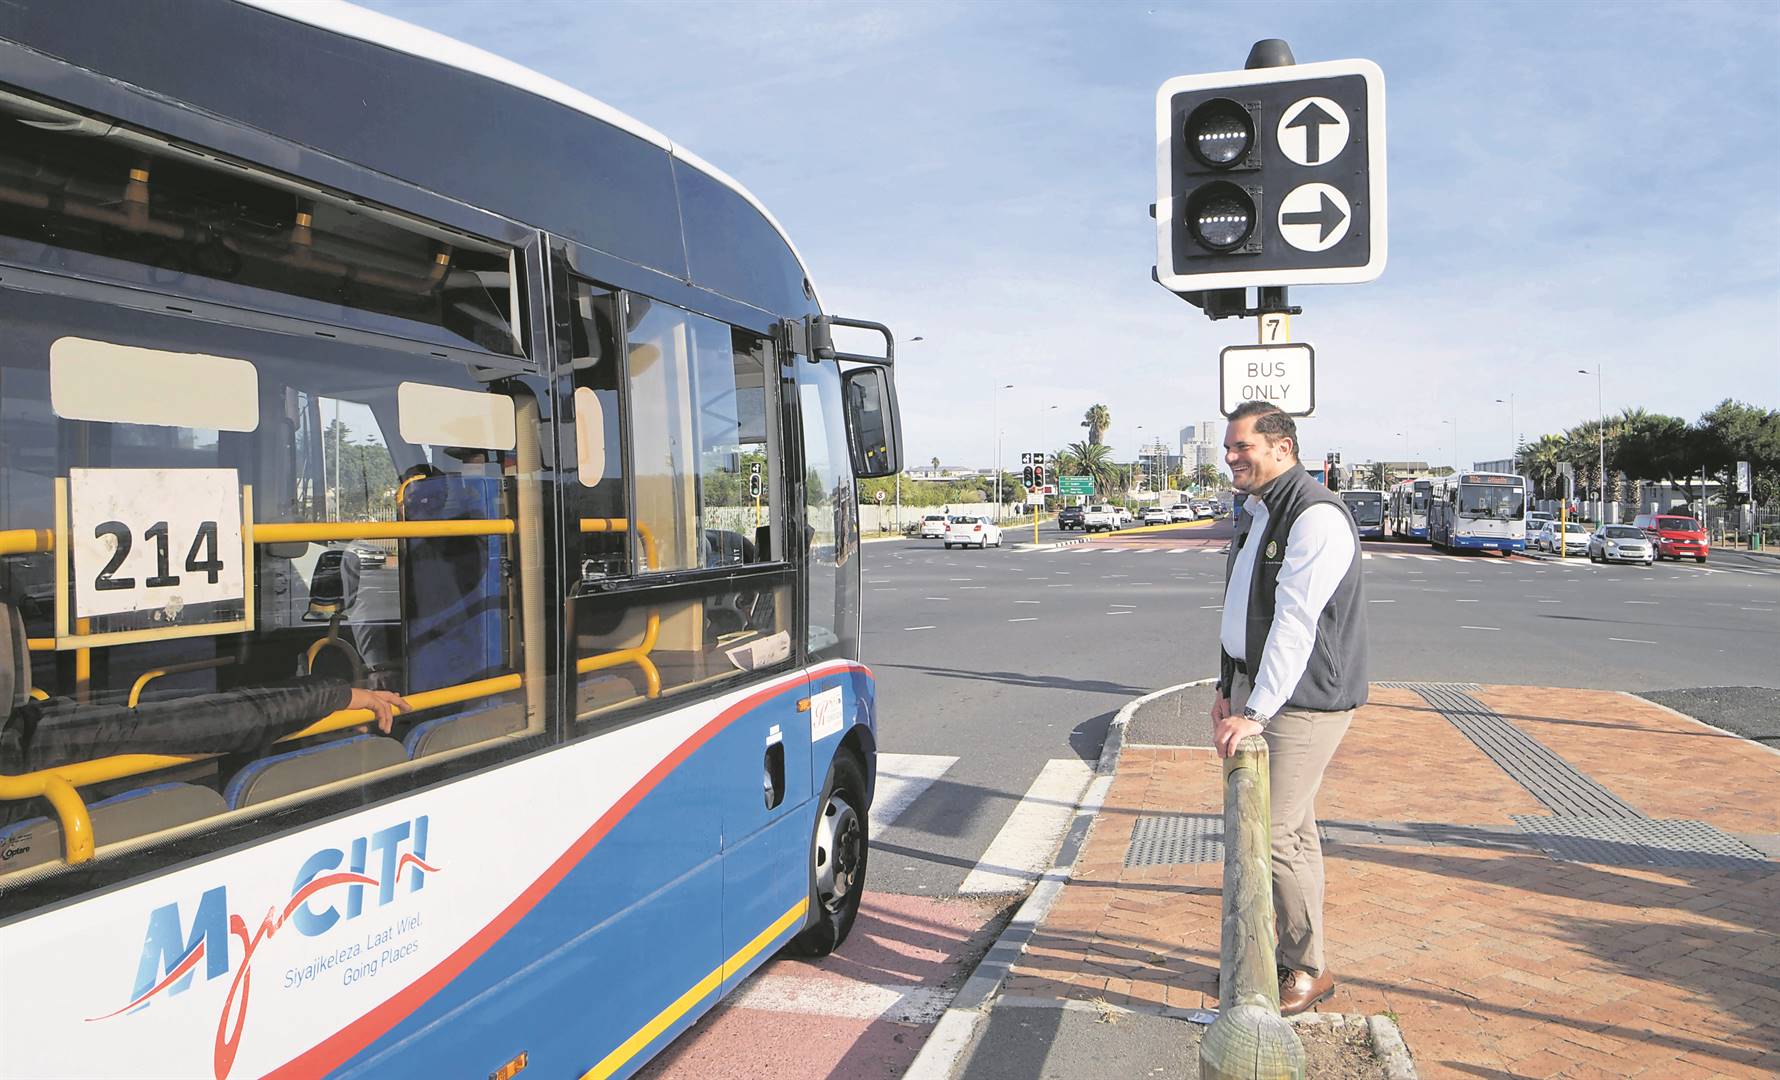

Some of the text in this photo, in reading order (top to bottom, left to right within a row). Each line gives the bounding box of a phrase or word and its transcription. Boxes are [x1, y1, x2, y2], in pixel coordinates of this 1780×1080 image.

[1266, 319, 1280, 341] 7
[1247, 361, 1286, 378] BUS
[1242, 384, 1290, 400] ONLY
[94, 520, 224, 591] 214
[367, 927, 393, 951] Laat
[343, 939, 418, 986] Going Places
